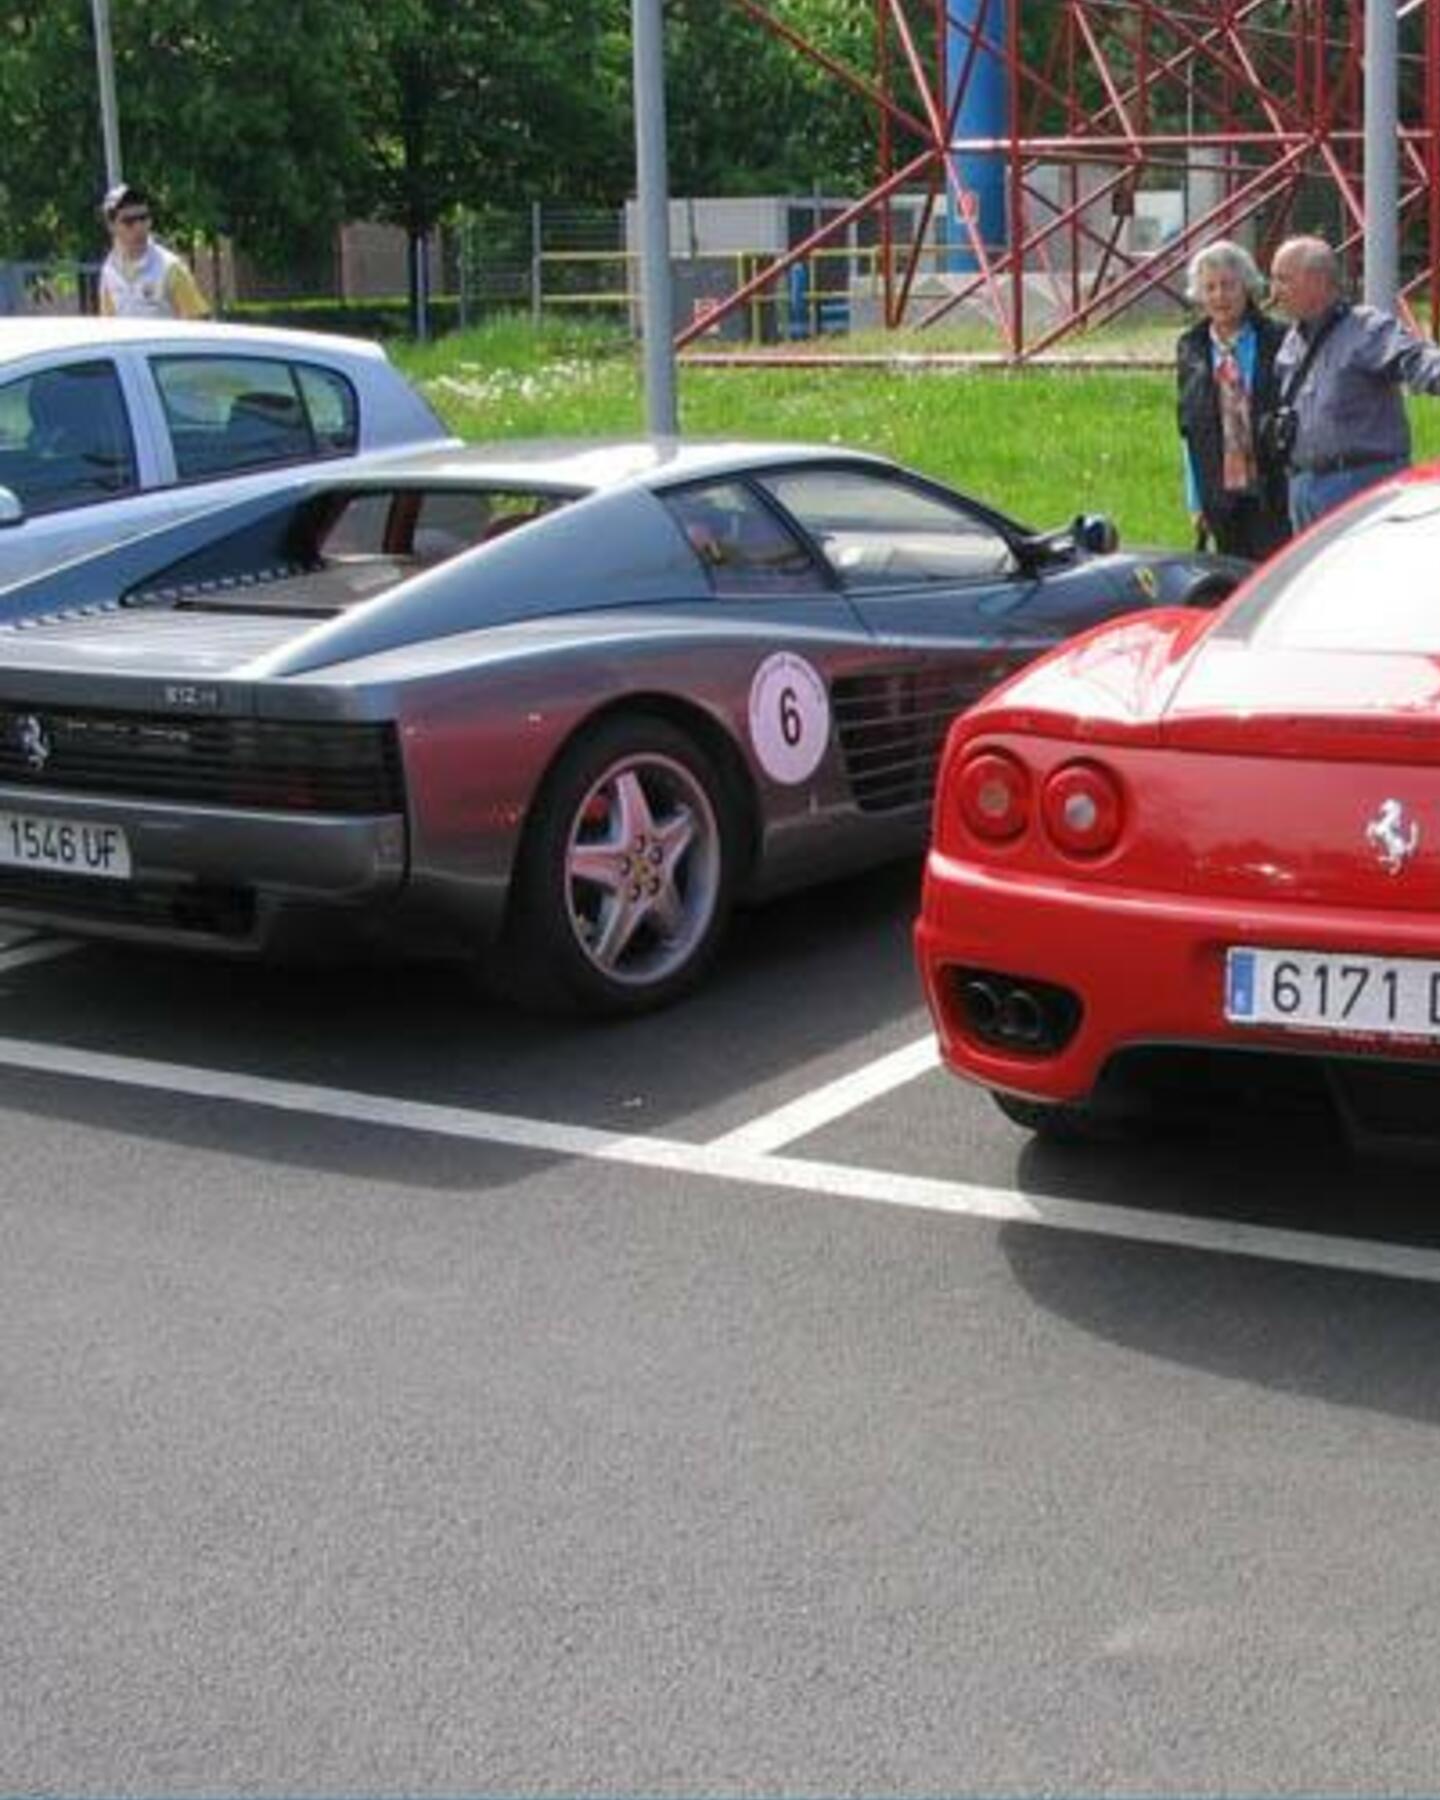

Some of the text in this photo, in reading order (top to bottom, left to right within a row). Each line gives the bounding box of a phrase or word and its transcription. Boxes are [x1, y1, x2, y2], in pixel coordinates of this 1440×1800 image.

[779, 686, 802, 747] 6
[9, 819, 118, 869] 1546 UF
[1271, 961, 1399, 1022] 6171
